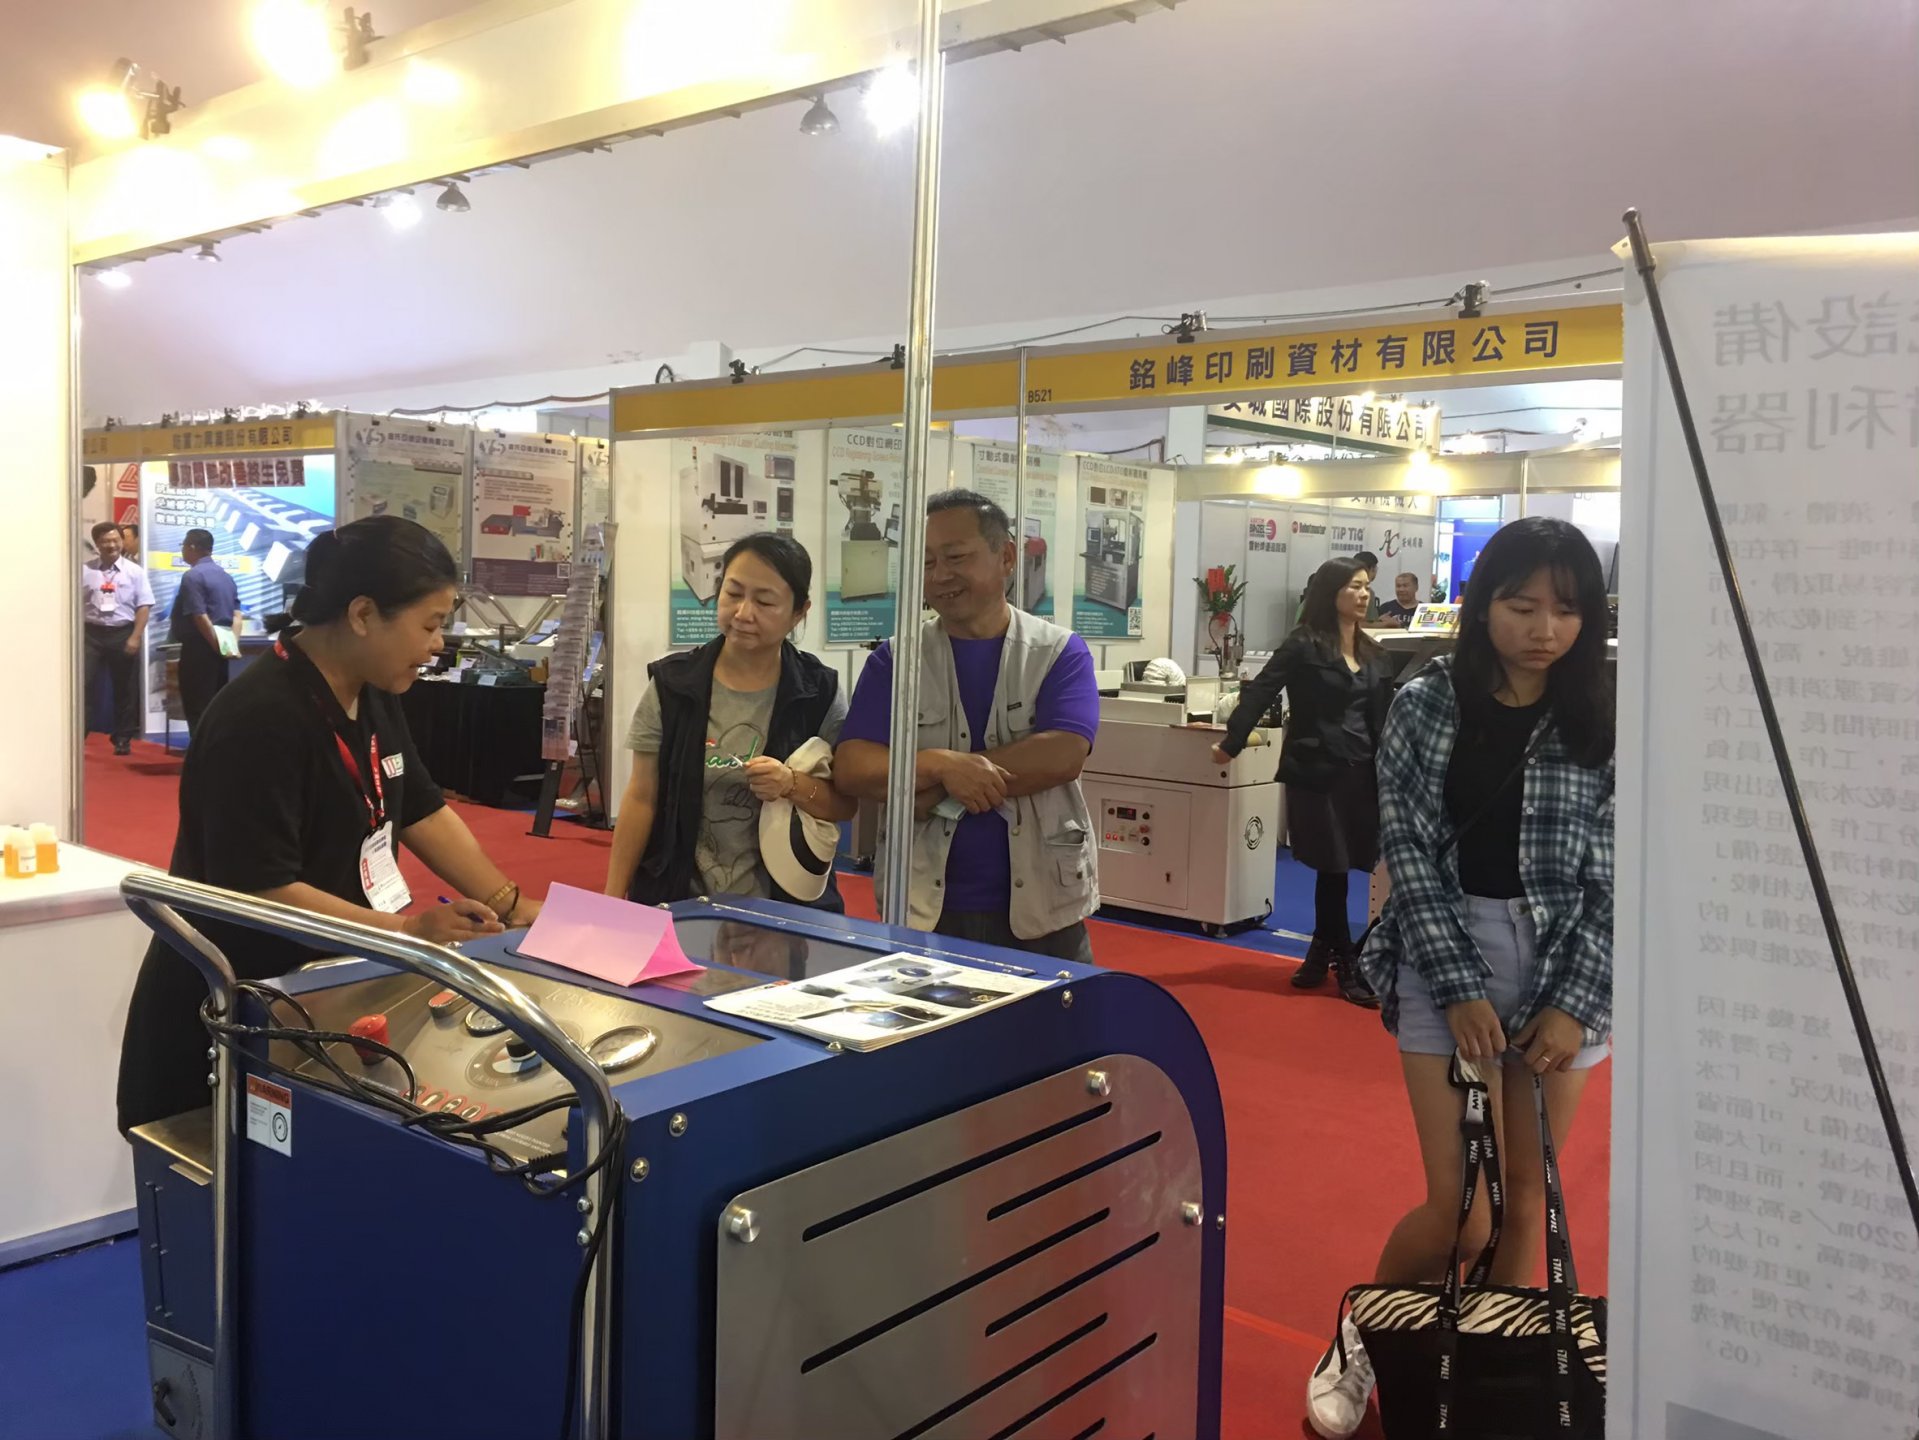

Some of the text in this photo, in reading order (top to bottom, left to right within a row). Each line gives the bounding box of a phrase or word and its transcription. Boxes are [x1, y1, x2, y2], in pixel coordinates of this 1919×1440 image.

[1129, 321, 1559, 390] 銘峰印刷資材有限公司
[1028, 389, 1052, 403] B521
